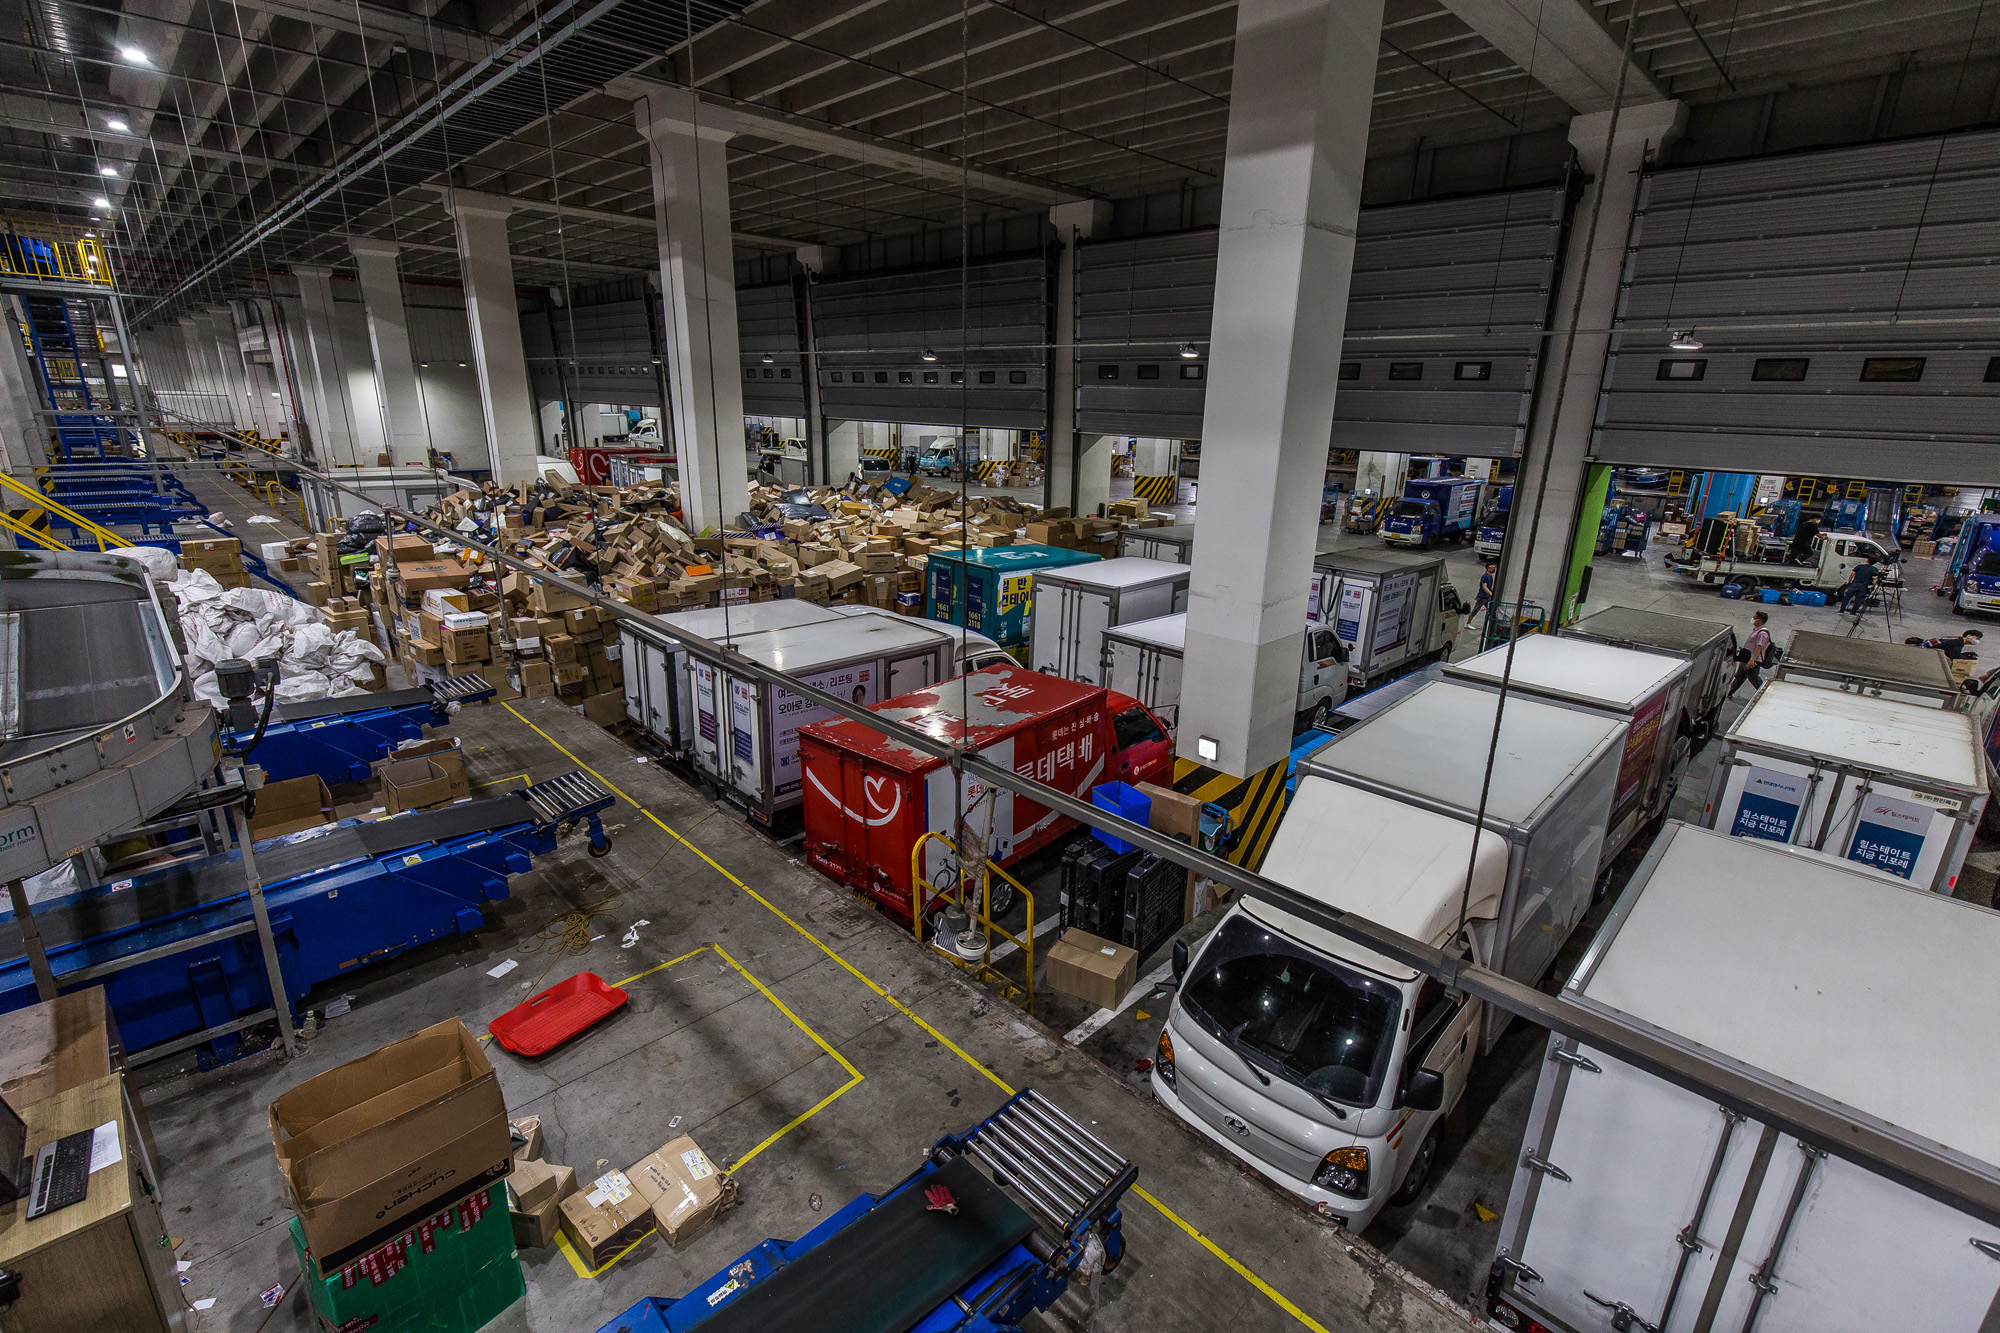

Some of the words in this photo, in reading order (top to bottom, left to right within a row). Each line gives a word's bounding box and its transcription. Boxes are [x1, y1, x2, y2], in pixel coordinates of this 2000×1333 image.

[936, 602, 949, 612] 1661
[936, 610, 949, 620] 2118
[968, 610, 981, 621] 1661
[968, 618, 981, 629] 2118
[829, 673, 853, 687] 리프팅
[778, 700, 802, 715] 오아로
[1051, 726, 1070, 742] 롯데는
[1742, 808, 1788, 829] 힐스테이트
[1891, 810, 1920, 823] 힐스테이트
[1739, 817, 1757, 829] 지금
[1758, 821, 1786, 837] 디포레
[1860, 839, 1911, 860] 힐스테이트
[1855, 848, 1876, 860] 지금
[1878, 853, 1910, 869] 디포레
